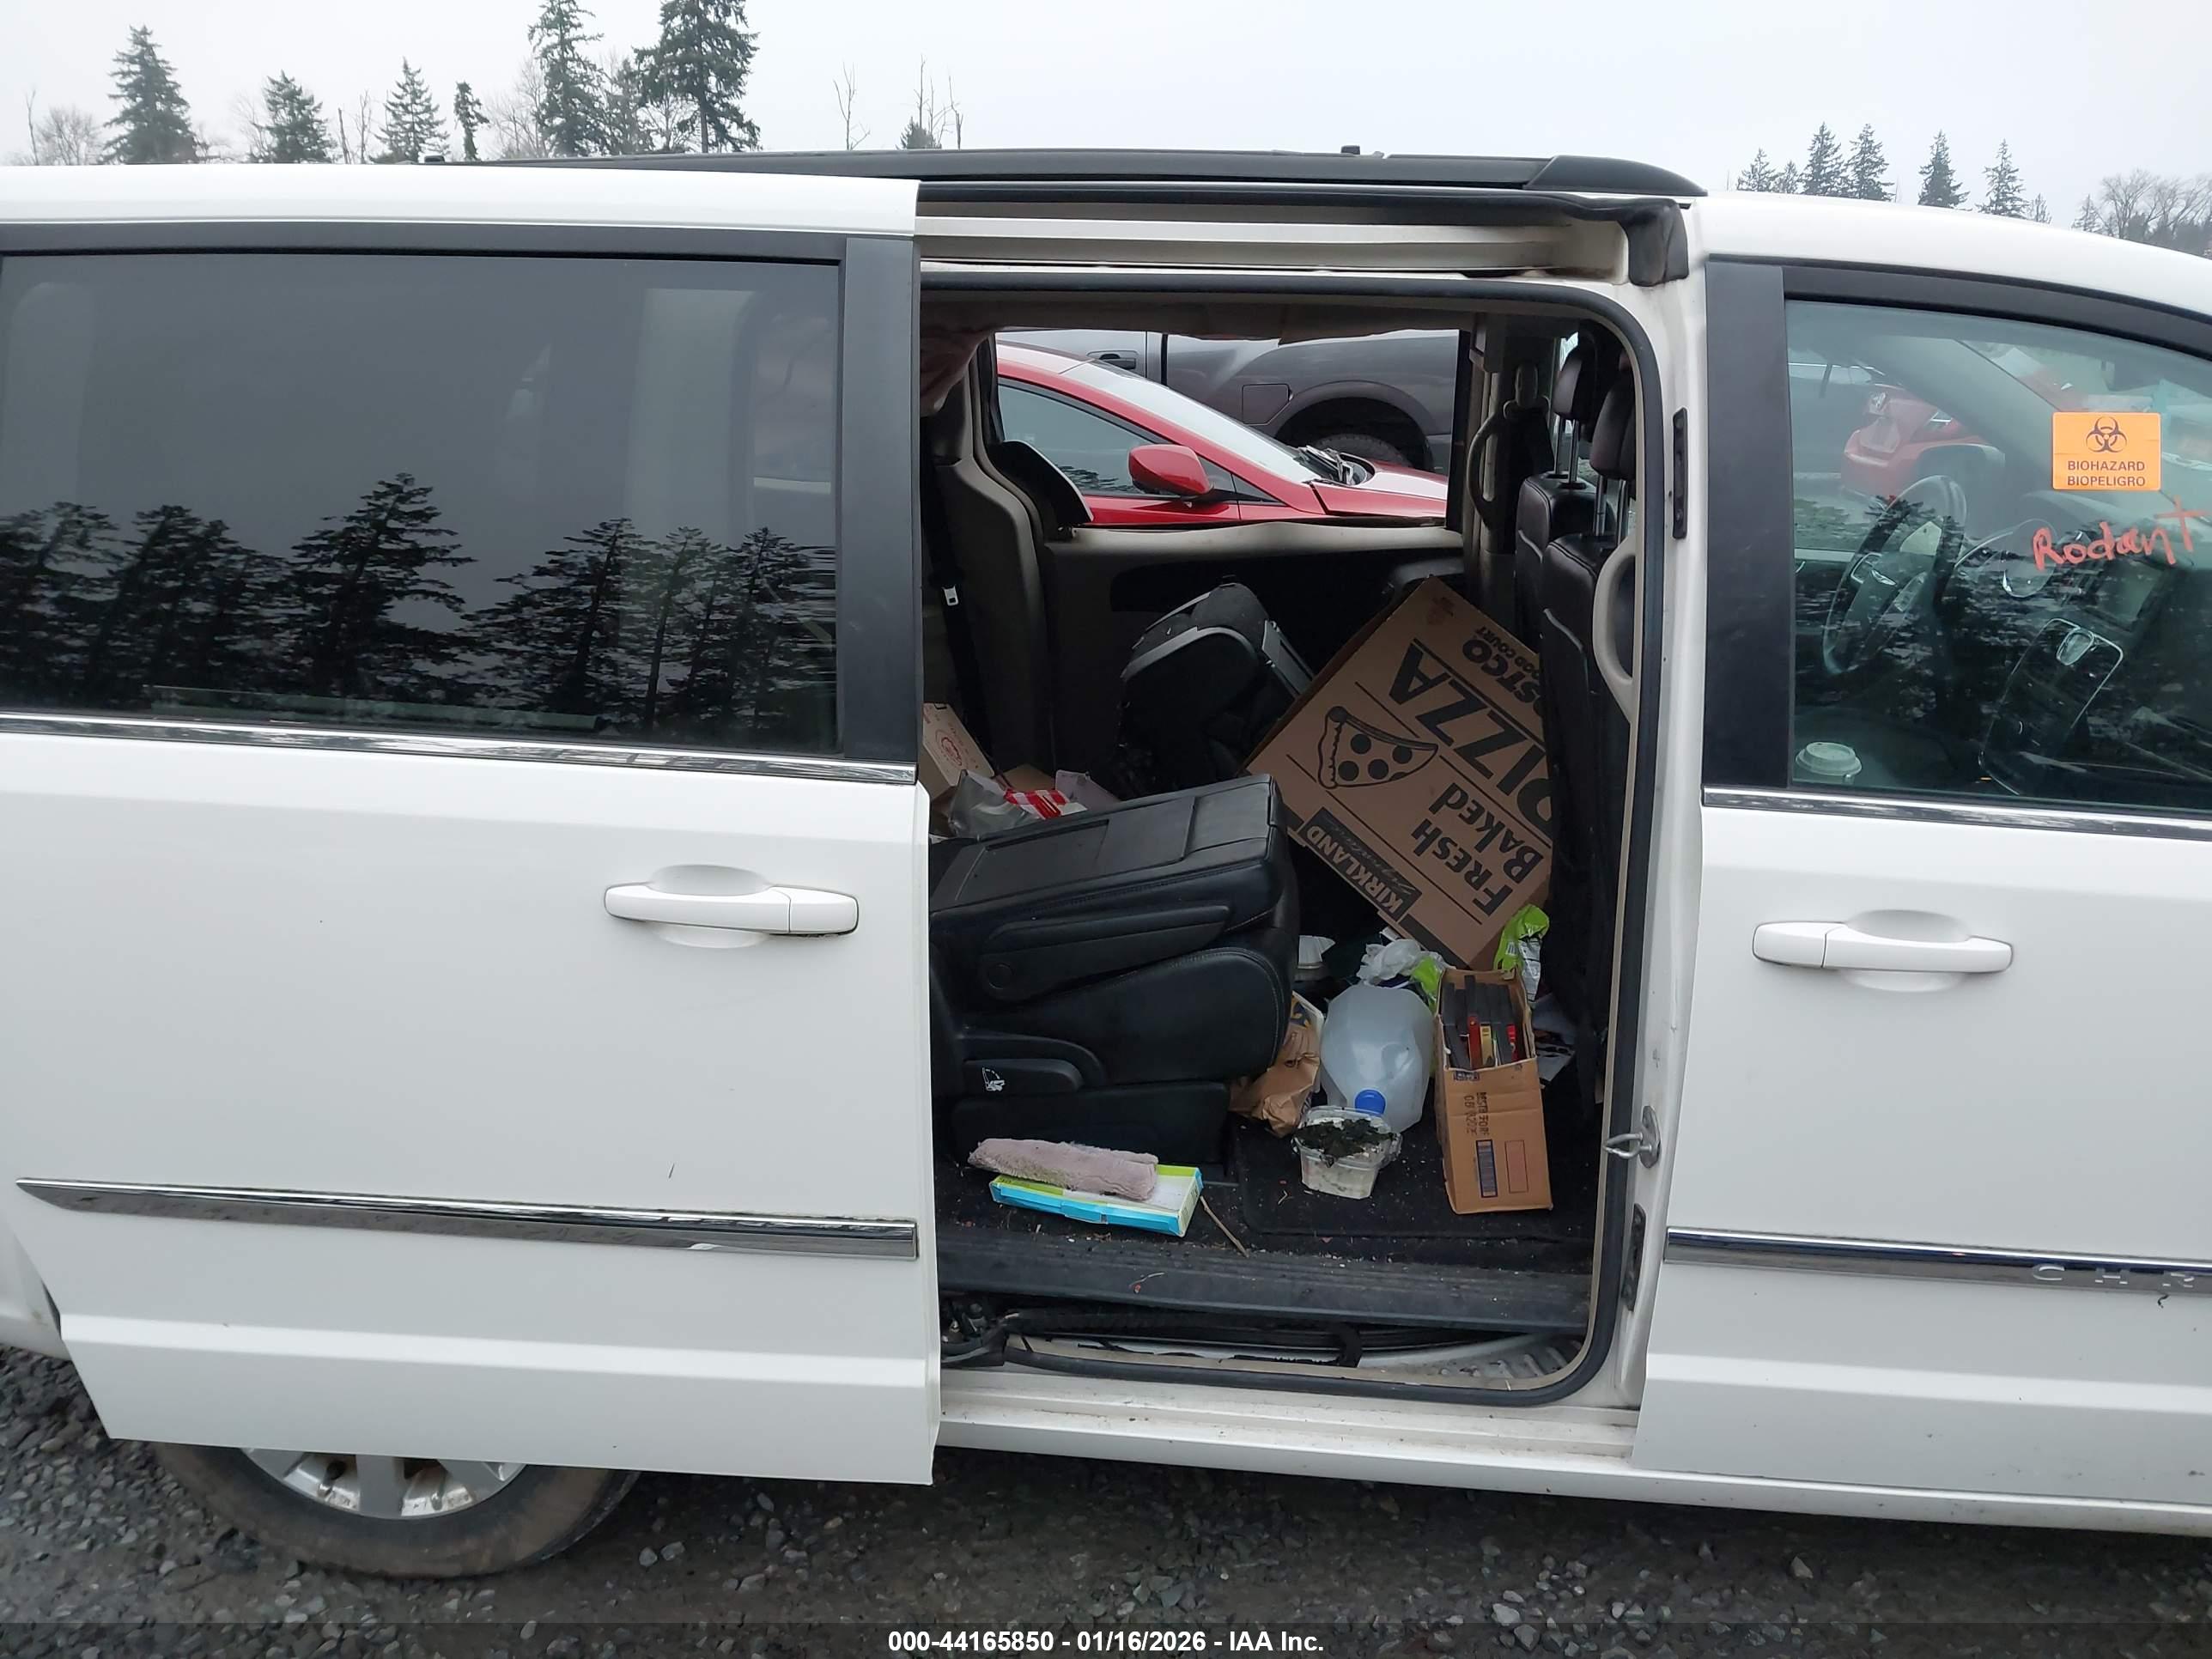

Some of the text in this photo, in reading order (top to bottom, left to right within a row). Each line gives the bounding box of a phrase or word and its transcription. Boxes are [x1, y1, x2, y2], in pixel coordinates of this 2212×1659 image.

[2067, 460, 2146, 471] BIOHAZARD
[2067, 475, 2146, 487] BIOPELIGRO
[1514, 656, 1540, 680] OOD
[1306, 825, 1403, 914] KIRKLAND
